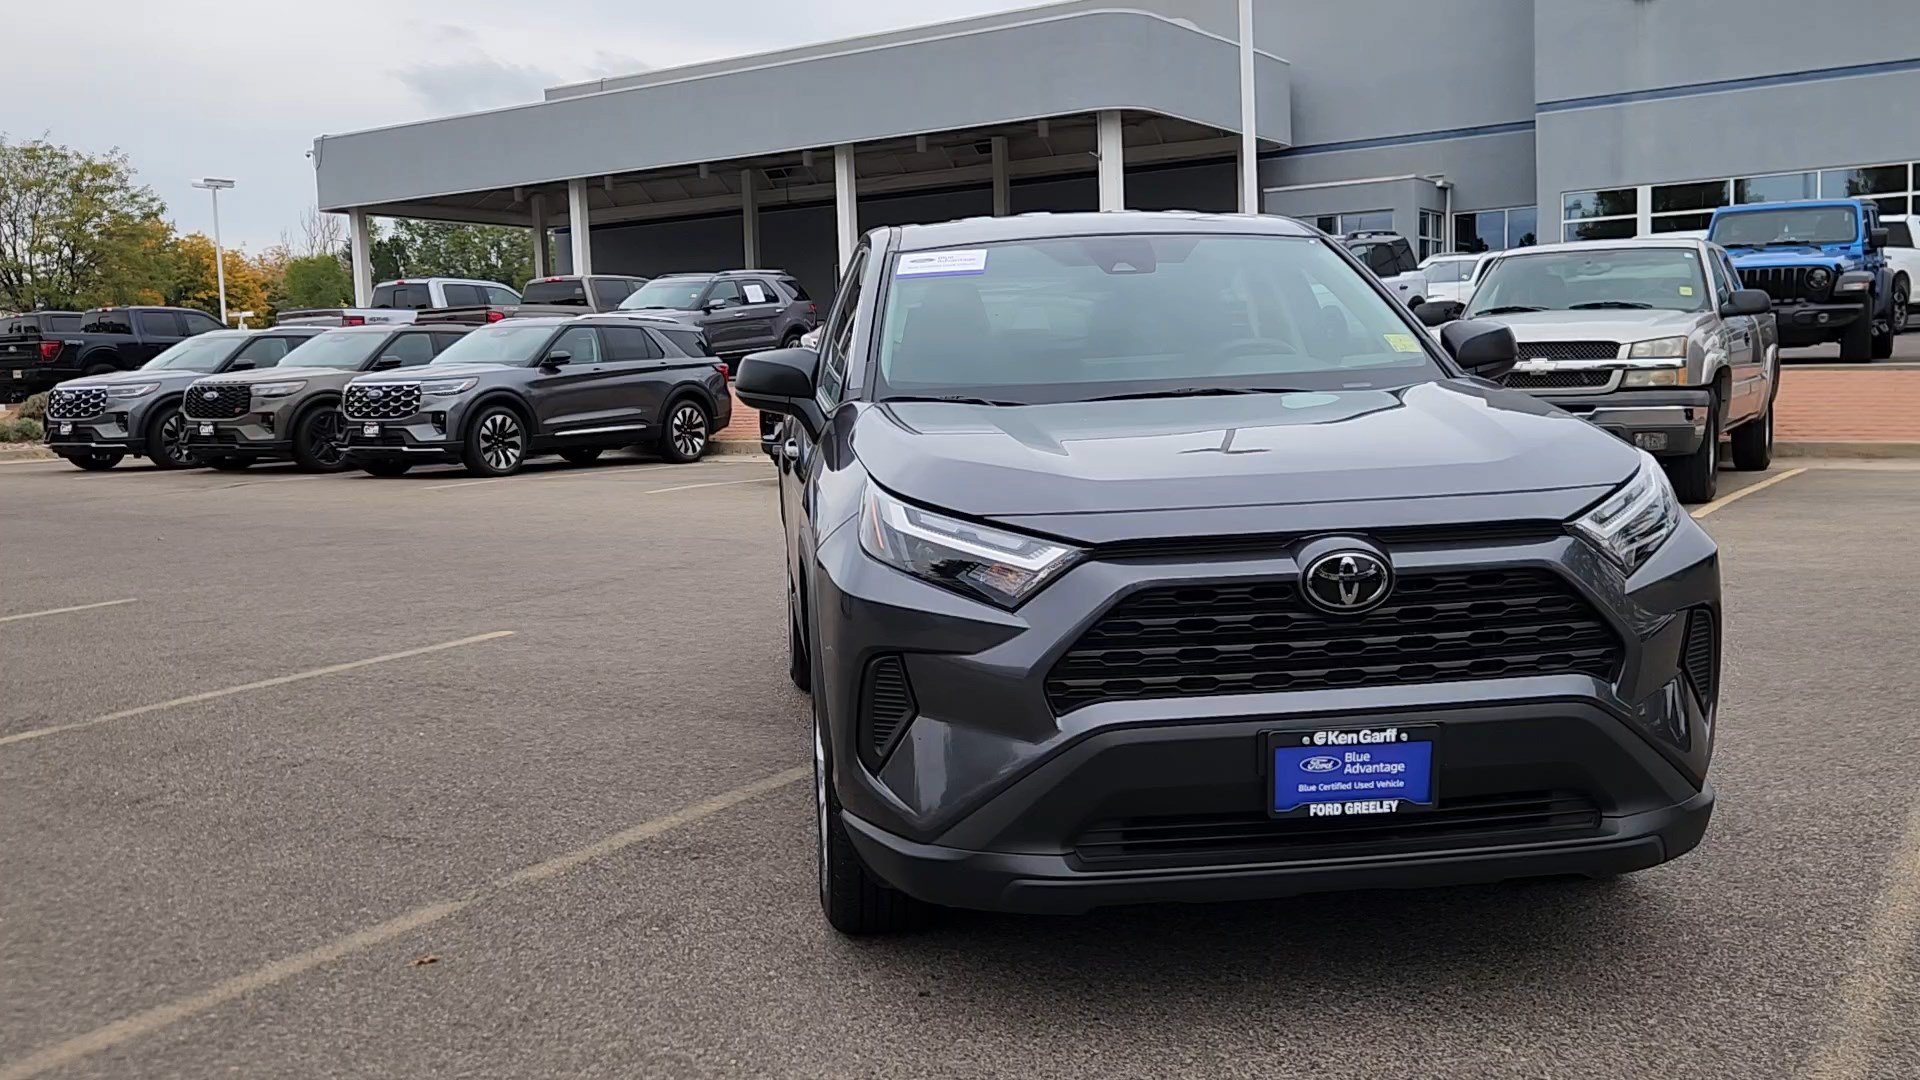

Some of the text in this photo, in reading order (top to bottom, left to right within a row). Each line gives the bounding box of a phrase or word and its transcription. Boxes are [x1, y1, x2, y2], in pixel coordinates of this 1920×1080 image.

[1327, 730, 1358, 745] Ken
[1358, 728, 1398, 743] Garff
[1344, 751, 1371, 762] Blue
[1343, 762, 1405, 774] Advantage
[1298, 779, 1405, 792] Blue Certified Used Vehicle
[1309, 800, 1399, 816] FORD GREELEY
